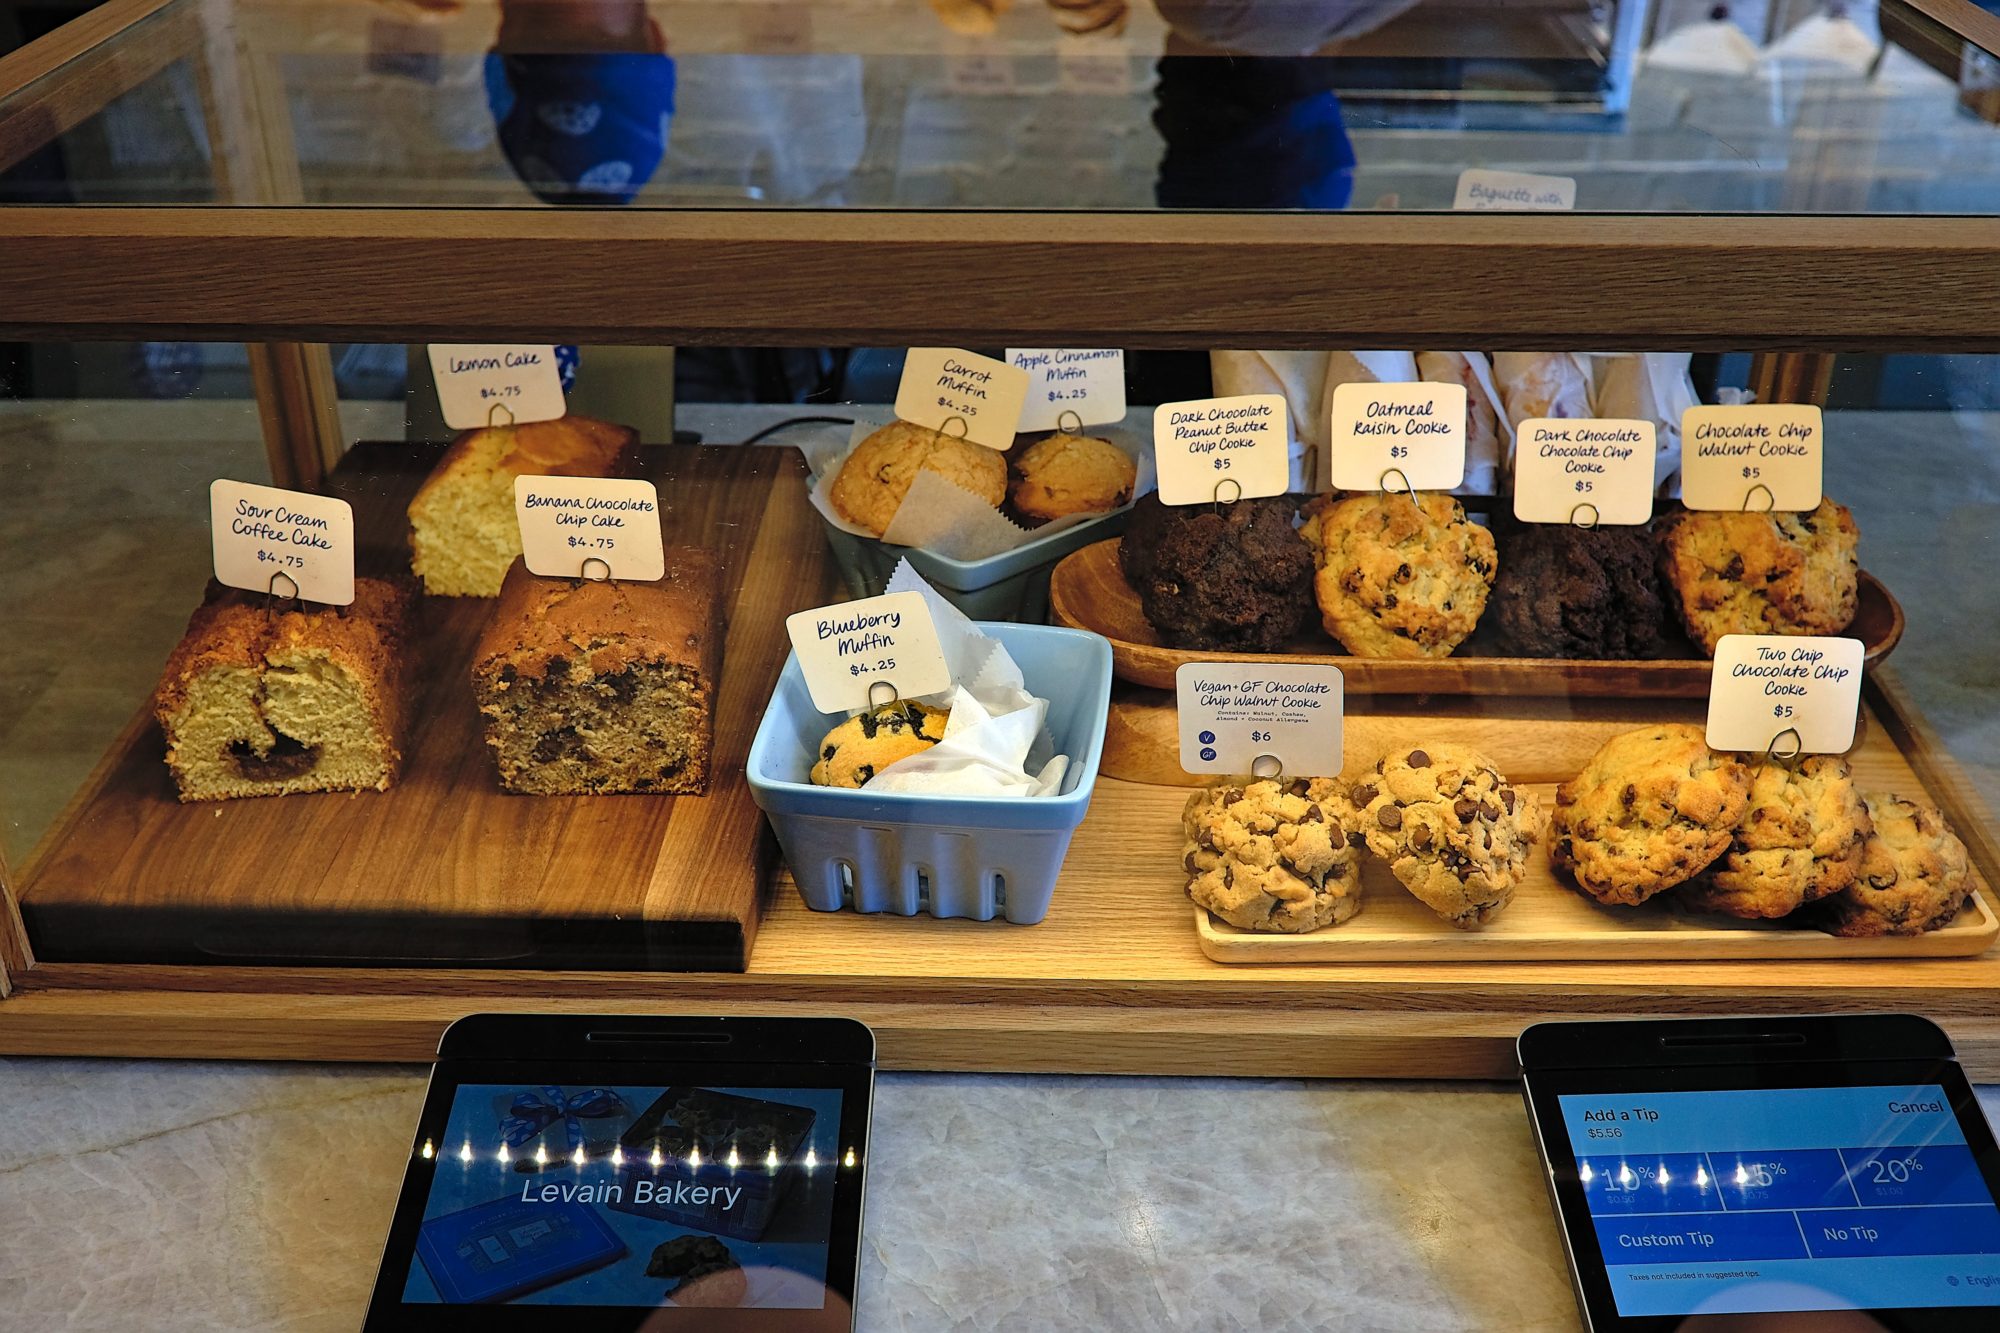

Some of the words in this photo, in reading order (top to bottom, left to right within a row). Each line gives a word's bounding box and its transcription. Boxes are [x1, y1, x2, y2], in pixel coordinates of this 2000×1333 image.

[450, 357, 501, 373] Lemon
[505, 352, 541, 368] Cake
[1014, 353, 1051, 370] Apple
[1055, 349, 1120, 365] Cinnamon
[943, 359, 992, 384] Carrot
[1046, 367, 1088, 382] Muffin
[480, 385, 521, 399] $4.75
[936, 376, 987, 399] Muffin
[1048, 389, 1087, 401] $4.25
[937, 396, 977, 416] $4.25
[1367, 400, 1433, 418] Oatmeal
[1170, 411, 1206, 425] Dark
[1208, 405, 1273, 421] Chocolate
[1174, 425, 1222, 440] Peanut
[1225, 422, 1269, 435] Butter
[1353, 420, 1401, 436] Raisin
[1405, 419, 1452, 435] Cookie
[1534, 429, 1572, 442] Dark
[1575, 428, 1642, 442] Chocolate
[1695, 422, 1772, 440] Chocolate
[1779, 421, 1813, 441] Chip
[1189, 441, 1216, 454] Chip
[1219, 438, 1256, 451] Cookie
[1391, 446, 1408, 458] $5
[1540, 444, 1600, 457] Chocolate
[1602, 445, 1633, 460] Chip
[1698, 441, 1756, 457] Walnut
[1759, 440, 1809, 457] Cookie
[1214, 458, 1231, 470] $5
[1565, 459, 1605, 473] Cookie
[1742, 466, 1760, 479] $5
[1575, 480, 1593, 492] $5
[525, 493, 584, 509] Banana
[586, 497, 654, 512] Chocolate
[236, 499, 273, 518] Sour
[275, 507, 328, 530] Cream
[556, 513, 587, 528] Chip
[592, 515, 625, 528] Cake
[232, 518, 288, 541] Coffee
[292, 528, 332, 550] Cake
[567, 536, 615, 549] $4.75
[257, 549, 303, 568] $4.75
[817, 612, 901, 640] Blueberry
[838, 633, 895, 656] Muffin
[1757, 647, 1787, 661] Two
[1791, 647, 1824, 665] Chip
[850, 658, 896, 677] $4.25
[1732, 663, 1810, 678] Chocolate
[1814, 664, 1849, 682] Chip
[1193, 680, 1231, 694] Vegan
[1240, 680, 1264, 693] GF
[1265, 680, 1331, 694] Chocolate
[1764, 680, 1808, 696] Cookie
[1200, 694, 1231, 709] Chip
[1234, 695, 1279, 707] Walnut
[1281, 696, 1322, 709] Cookie
[1774, 704, 1793, 718] $5
[1252, 730, 1271, 743] $6
[1202, 751, 1213, 759] GF
[1584, 1109, 1616, 1122] Add
[1620, 1111, 1630, 1121] a
[1632, 1108, 1659, 1123] Tip
[1888, 1101, 1945, 1114] Cancel
[1588, 1127, 1623, 1139] $5.56
[1601, 1166, 1656, 1192] 10%
[1866, 1158, 1923, 1183] 20%
[521, 1179, 623, 1204] Levain
[633, 1180, 742, 1211] Bakery
[1619, 1233, 1684, 1248] Custom
[1687, 1231, 1714, 1248] Tip
[1823, 1228, 1848, 1241] No
[1849, 1226, 1879, 1243] Tip
[1652, 1273, 1664, 1281] not
[1664, 1272, 1696, 1280] included
[1706, 1271, 1744, 1280] suggested
